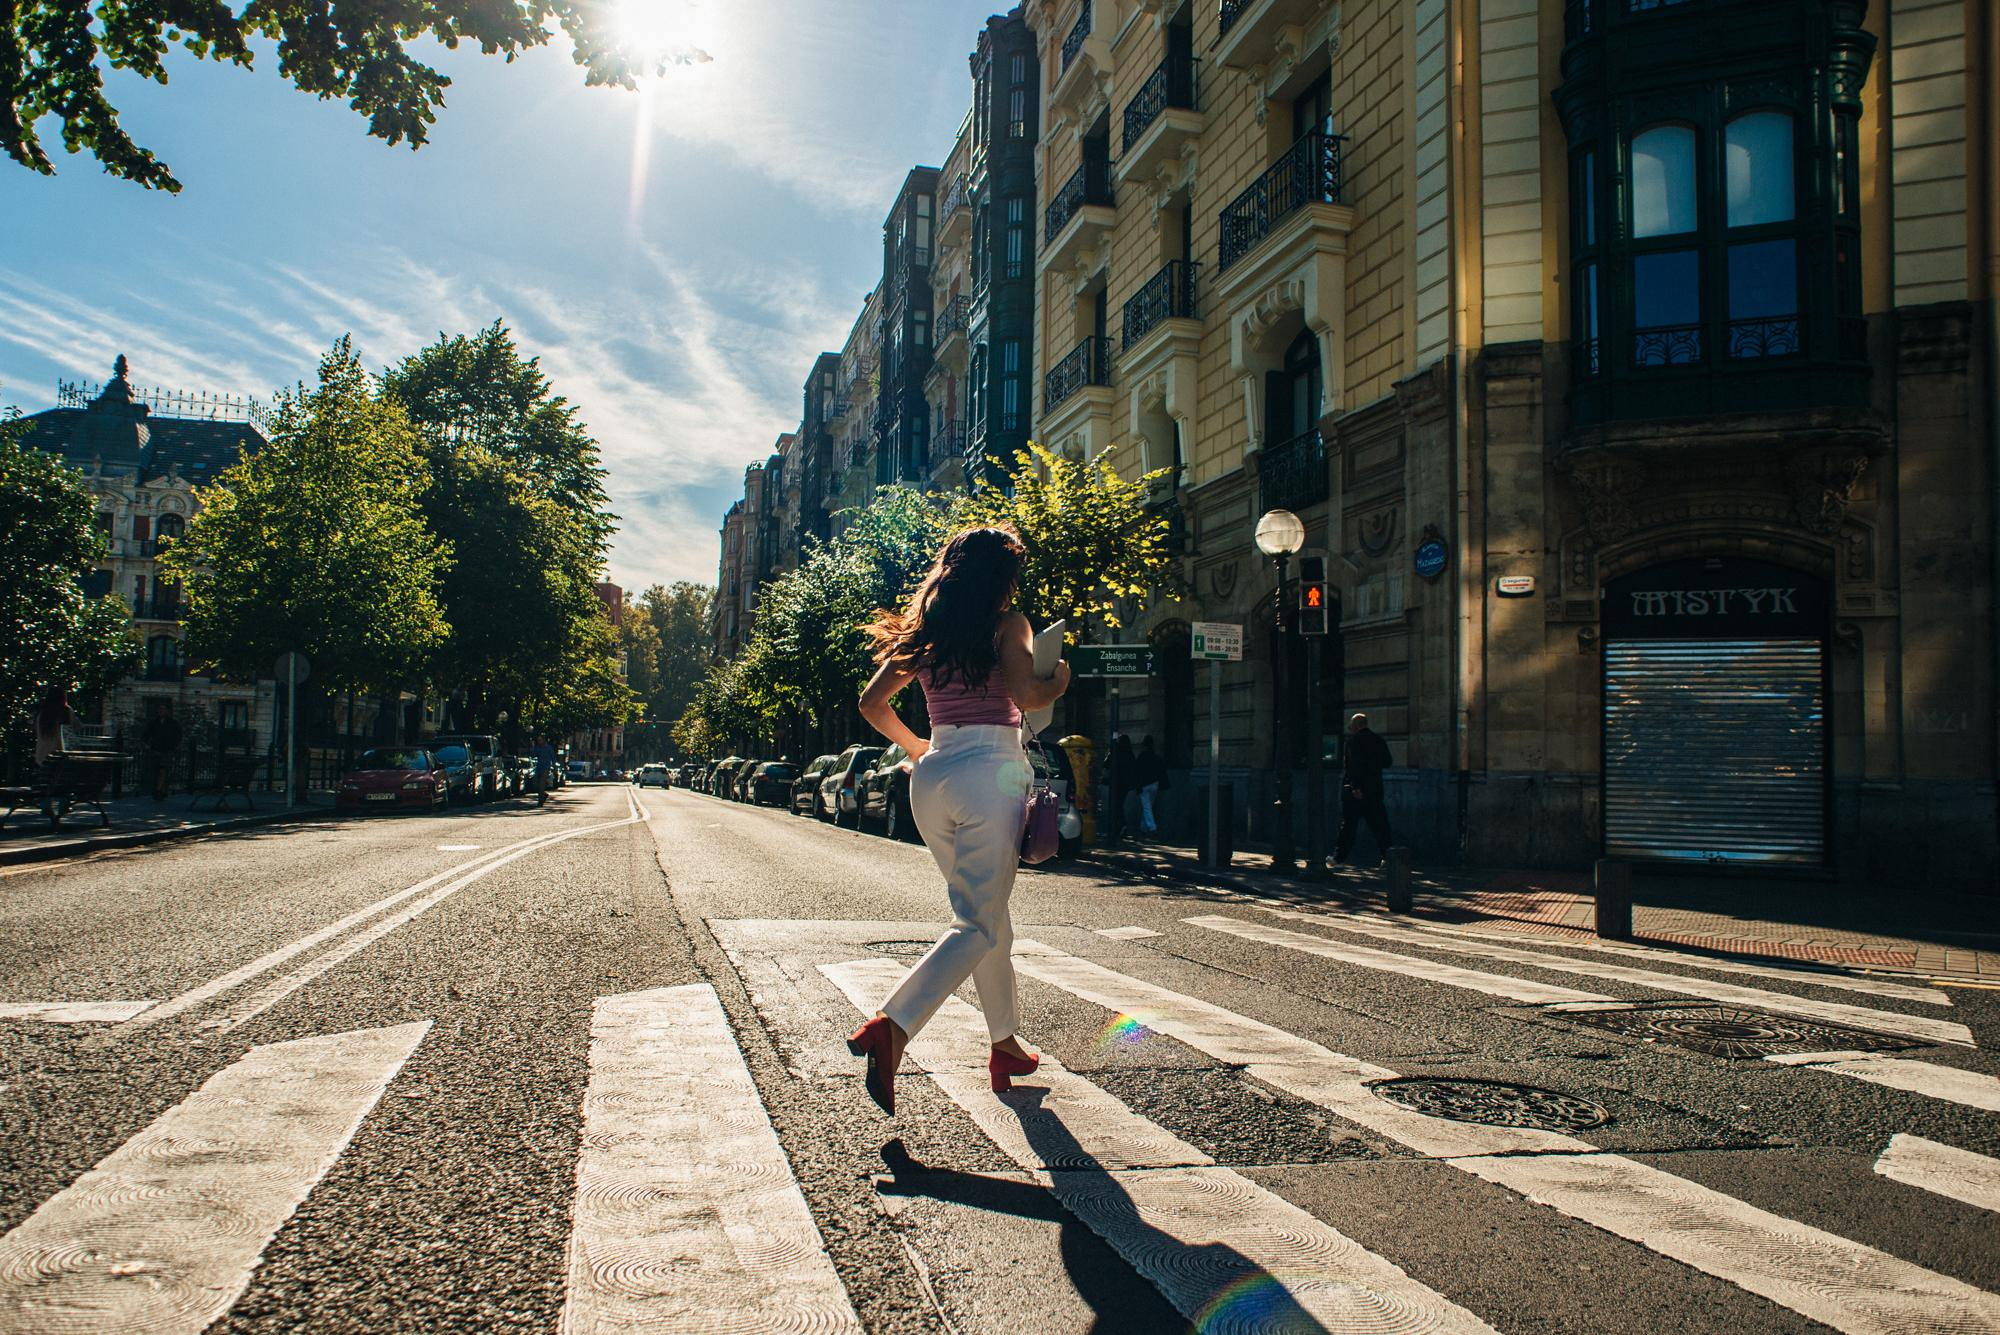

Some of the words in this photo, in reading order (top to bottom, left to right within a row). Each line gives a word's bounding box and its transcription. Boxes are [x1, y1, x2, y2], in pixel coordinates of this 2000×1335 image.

[1631, 588, 1799, 616] MISTYK
[1197, 639, 1201, 648] 1
[1100, 650, 1137, 662] Zabalgunea
[1106, 663, 1137, 672] Ensanche
[1146, 663, 1152, 671] P
